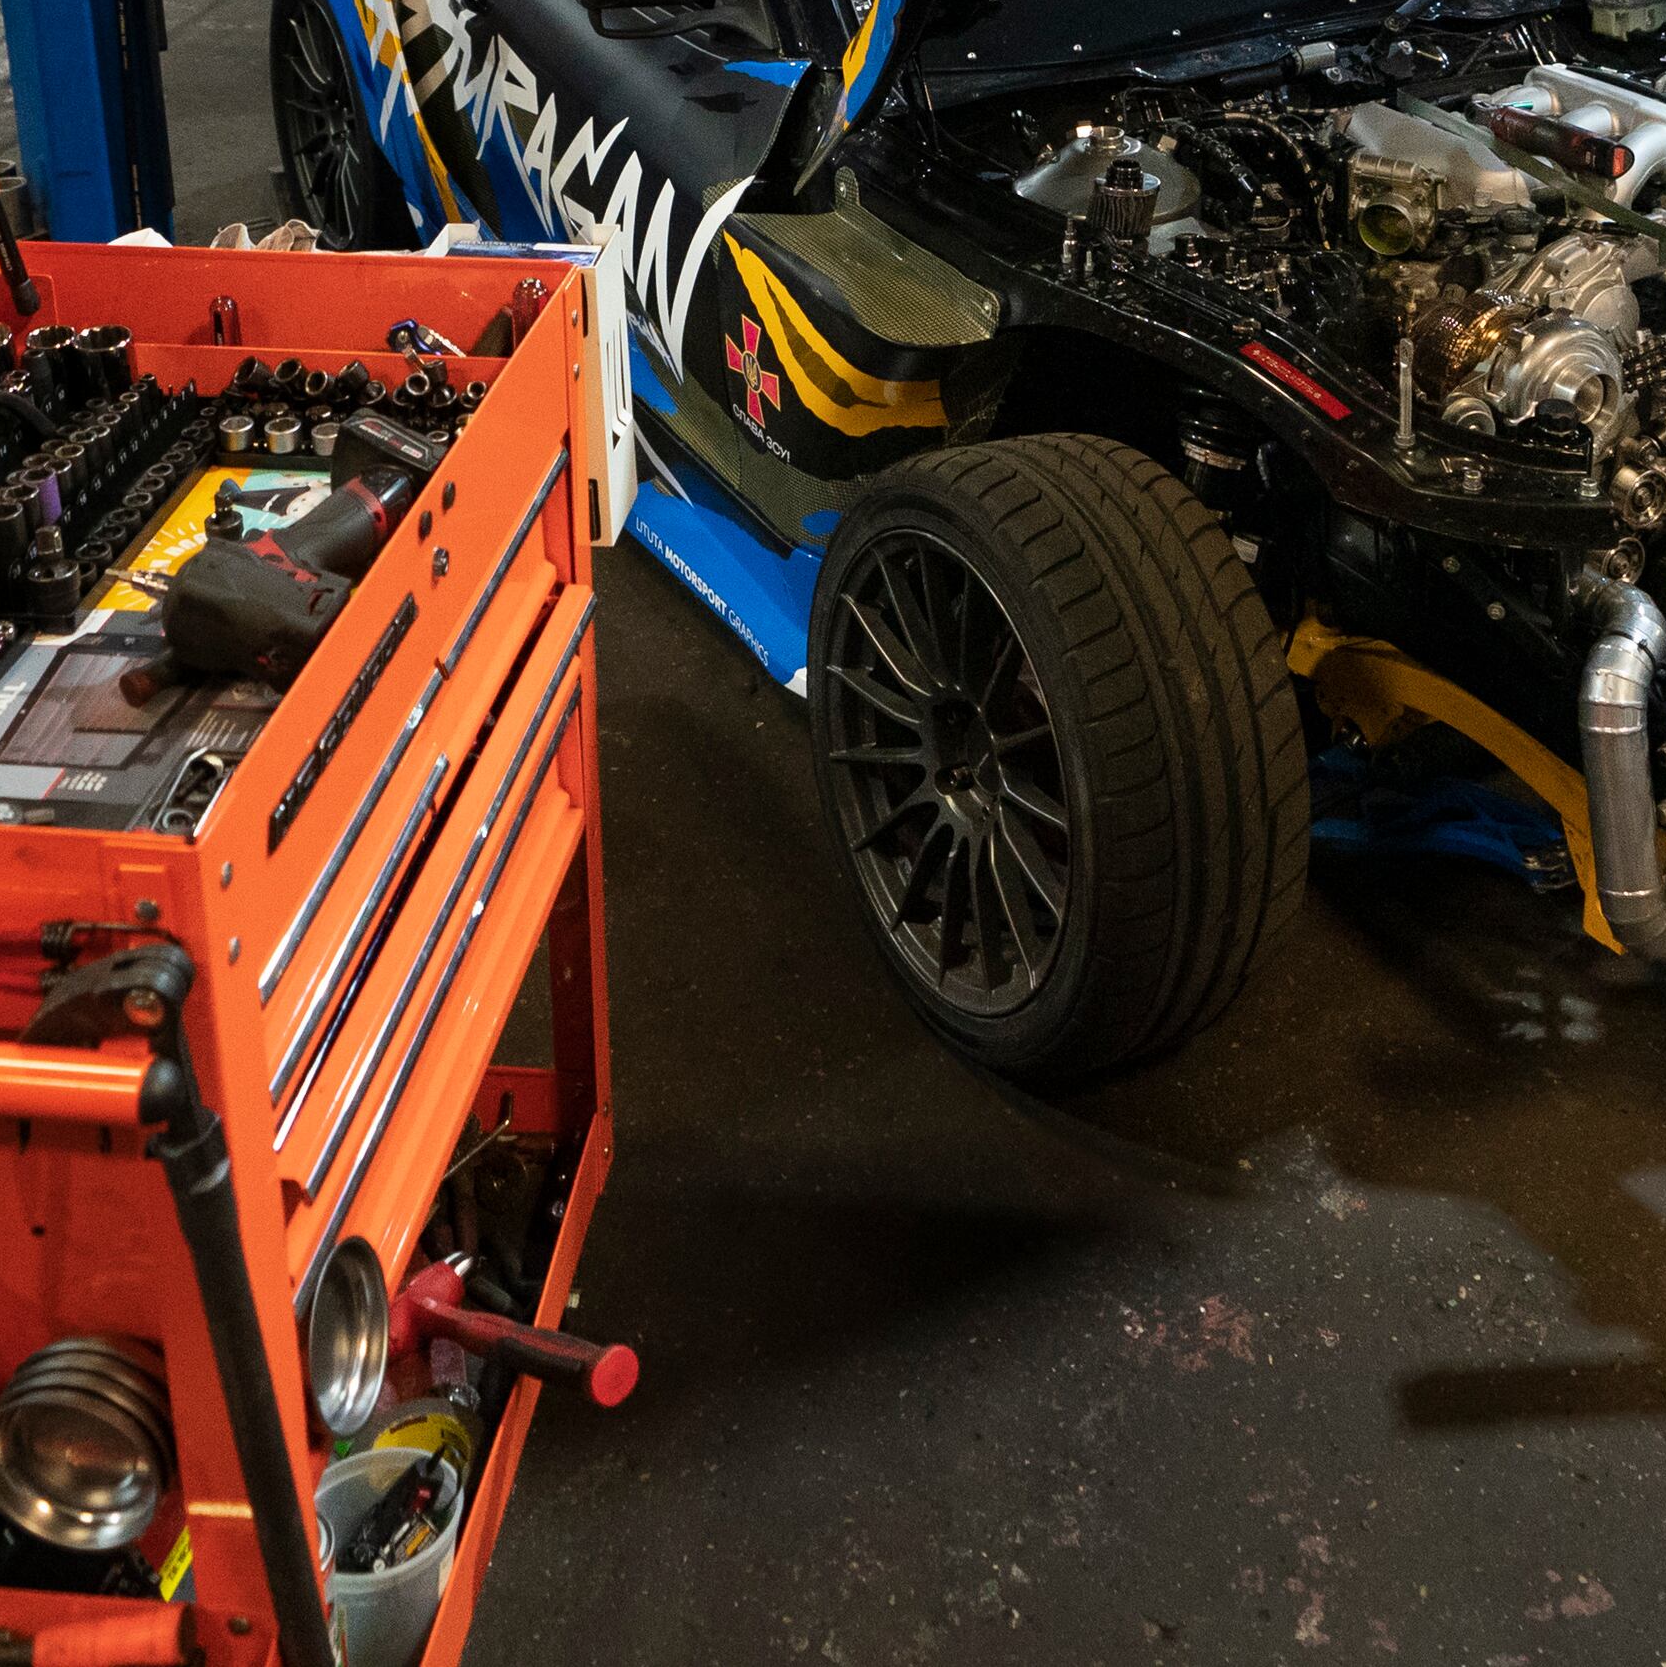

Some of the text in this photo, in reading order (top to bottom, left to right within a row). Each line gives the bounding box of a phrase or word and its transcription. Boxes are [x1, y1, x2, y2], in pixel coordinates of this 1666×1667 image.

[733, 403, 790, 463] СЛАВА ЗСУ!
[665, 545, 727, 616] MOTORSPORT
[728, 609, 769, 667] GRAPHICS
